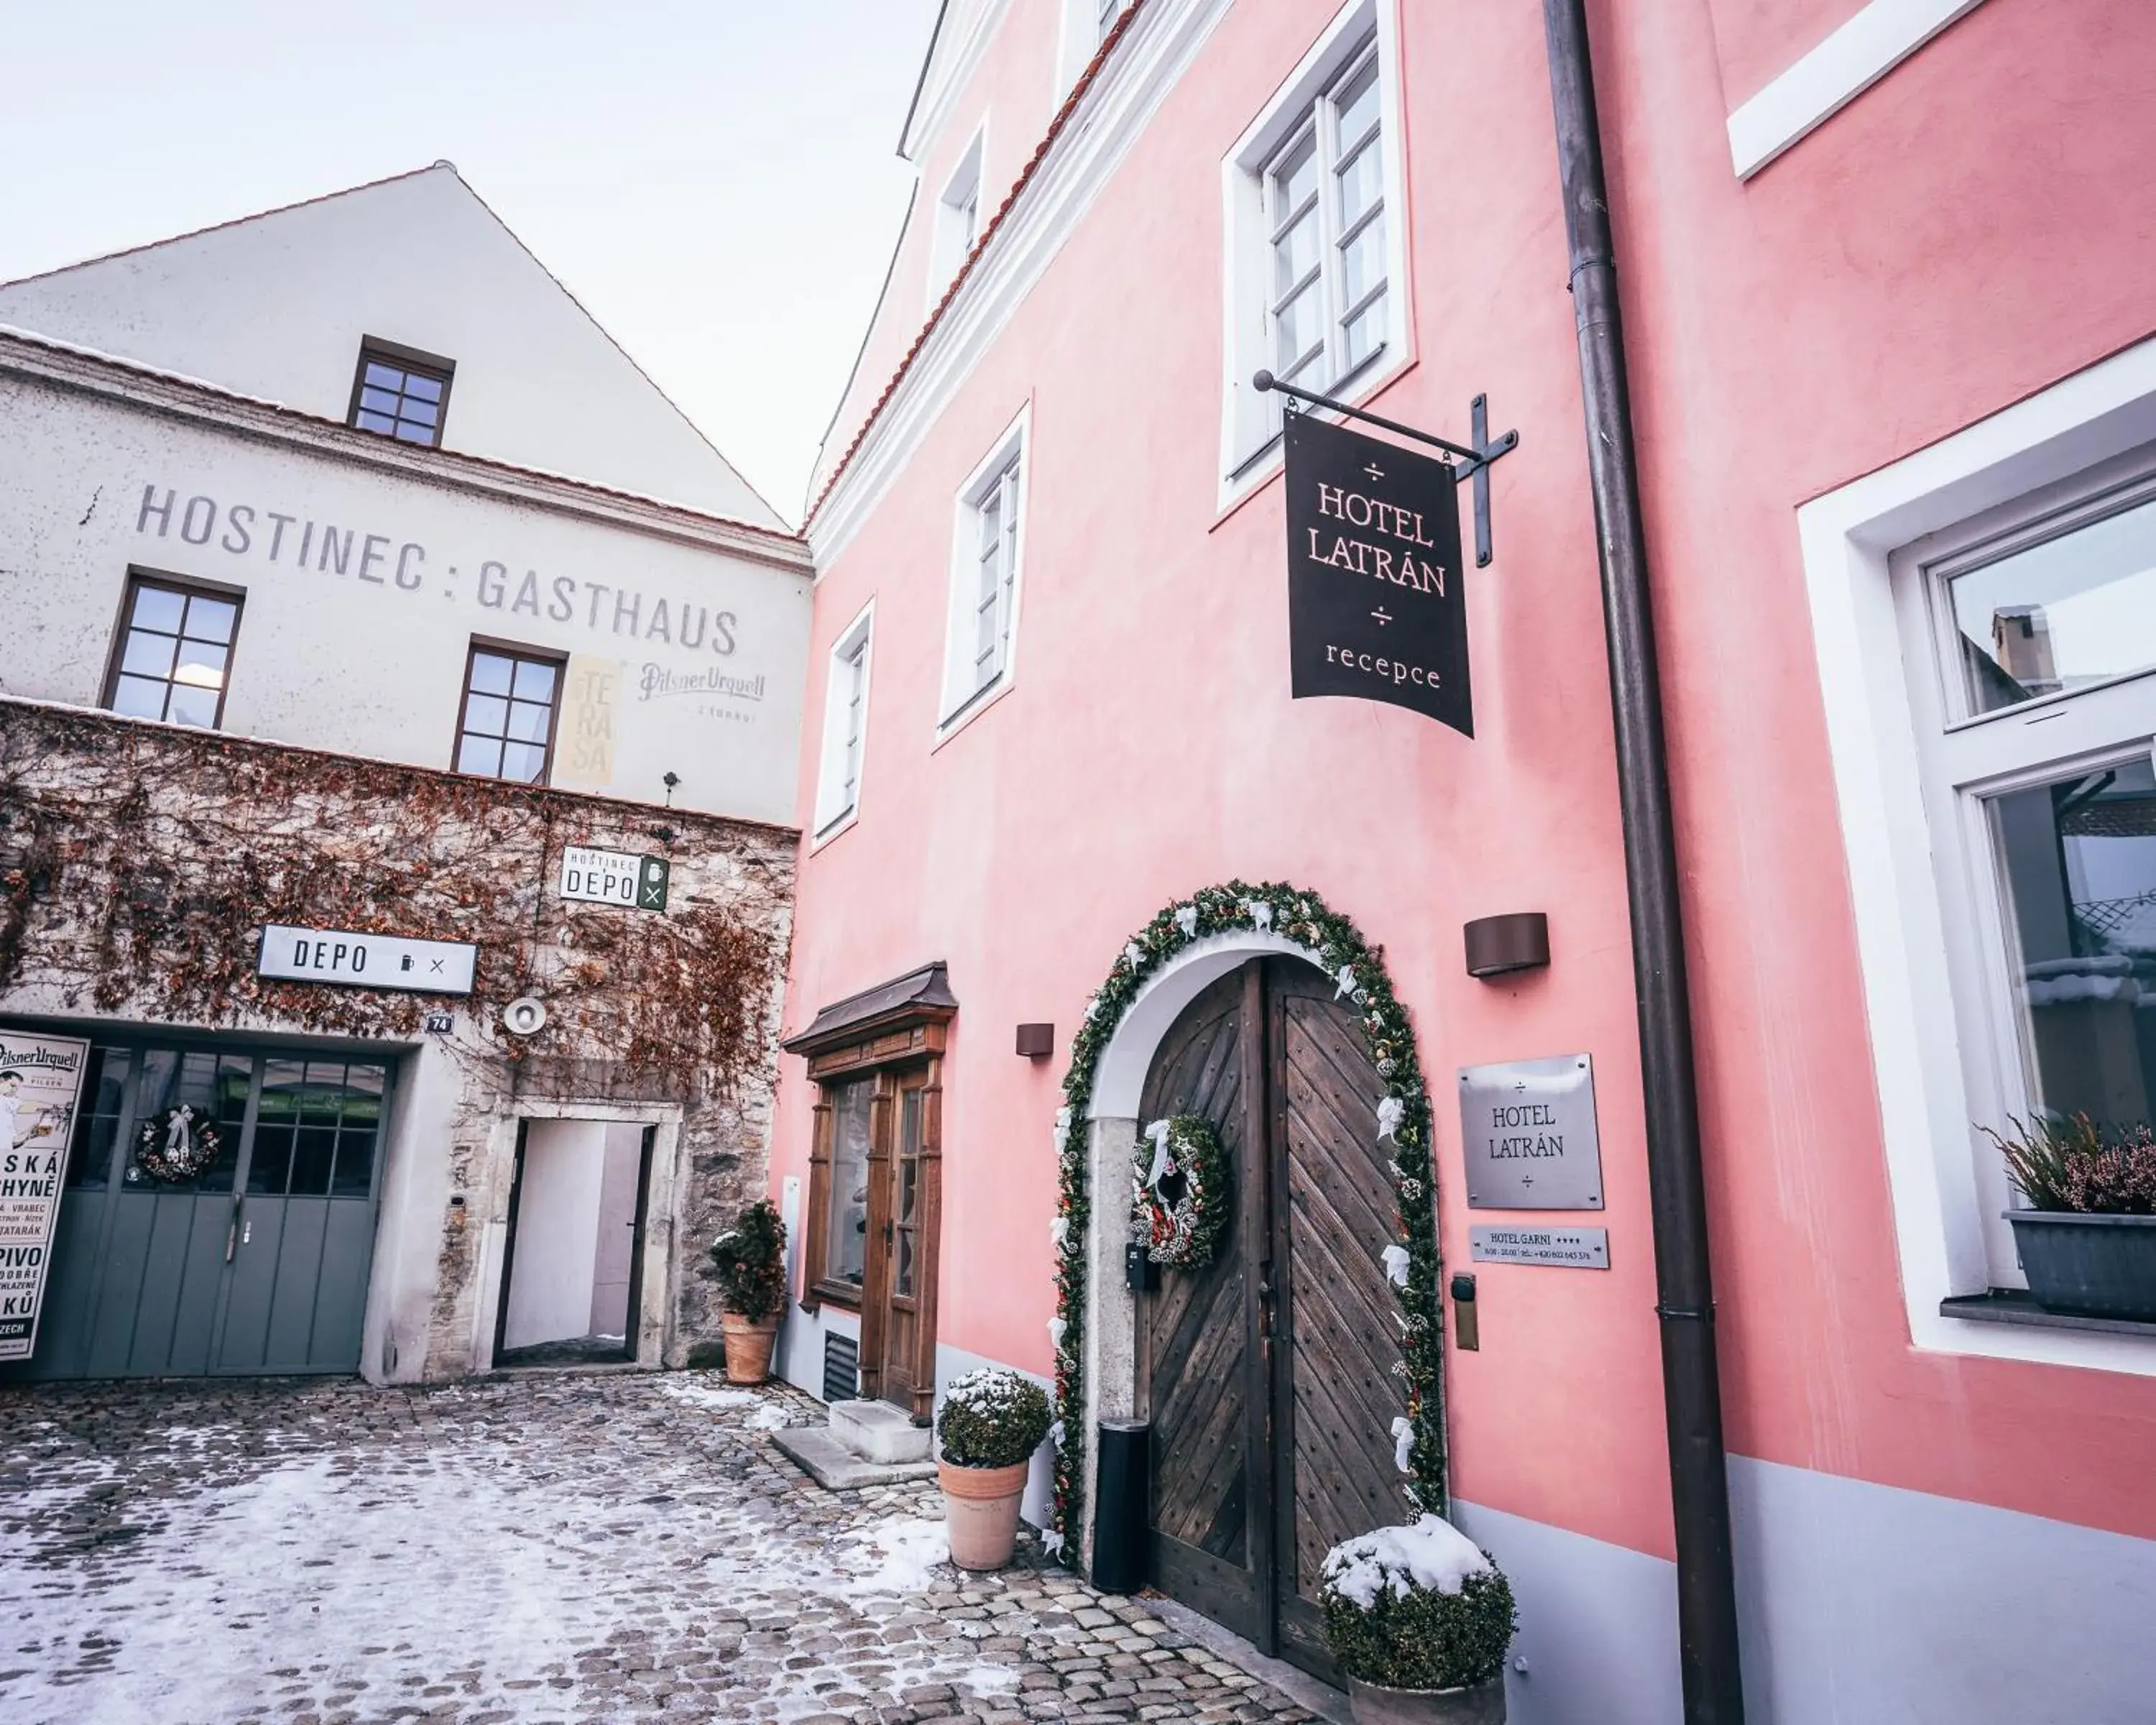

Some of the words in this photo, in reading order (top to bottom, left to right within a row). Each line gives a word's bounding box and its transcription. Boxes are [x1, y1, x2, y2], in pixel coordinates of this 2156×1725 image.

[1318, 482, 1434, 548] HOTEL
[136, 484, 425, 590] HOSTINEC
[477, 561, 737, 656] GASTHAUS
[1308, 528, 1446, 598] LATRÁN
[1327, 644, 1441, 689] recepce
[571, 852, 635, 872] HOSTINEC
[567, 870, 633, 899] DEPO
[293, 939, 368, 973] DEPO
[433, 1018, 446, 1030] 74
[35, 1046, 78, 1071] Urquell
[1492, 1104, 1556, 1128] HOTEL
[1488, 1132, 1565, 1159] LATRÁN
[0, 1175, 55, 1197] HYNĚ
[12, 1203, 46, 1213] VRABEC
[1491, 1233, 1519, 1244] HOTEL
[1520, 1234, 1551, 1246] GARNI
